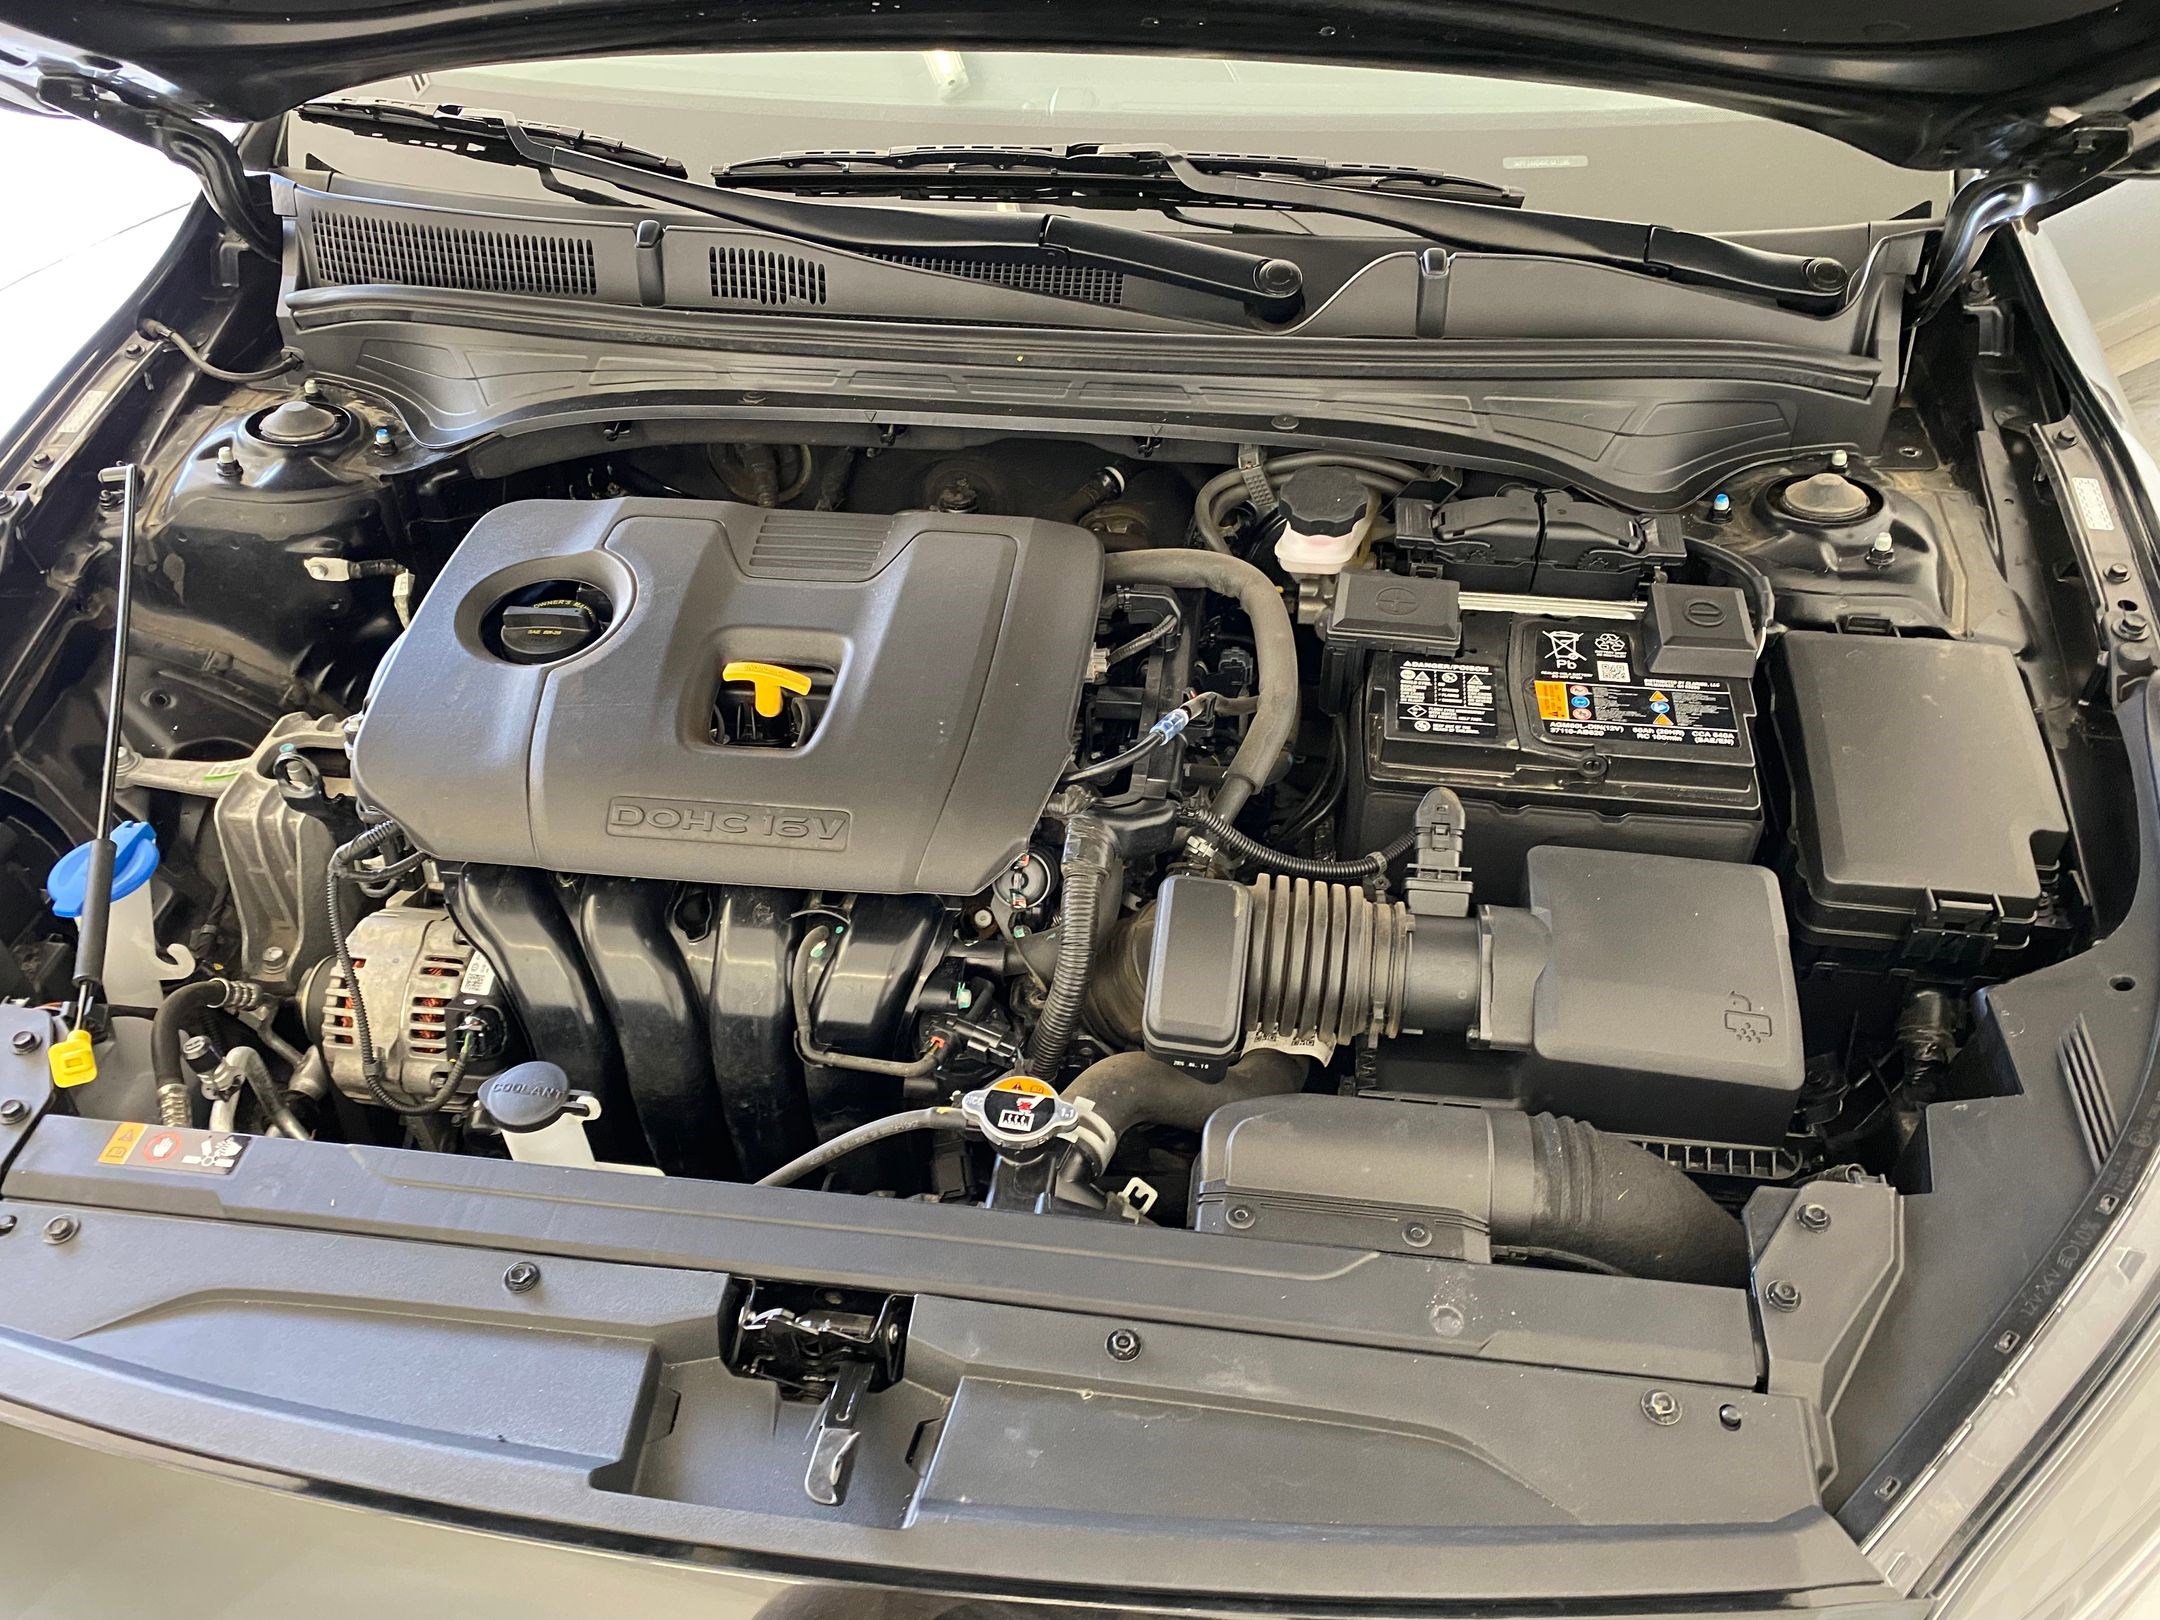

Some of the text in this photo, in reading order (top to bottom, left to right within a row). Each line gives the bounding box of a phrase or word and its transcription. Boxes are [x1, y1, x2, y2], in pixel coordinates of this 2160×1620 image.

[533, 599, 572, 609] OWNER'S
[1411, 661, 1489, 673] DANGER/POISON
[1556, 659, 1578, 670] Pb
[610, 804, 847, 841] DOHC 16V
[493, 1082, 562, 1100] COOLANT
